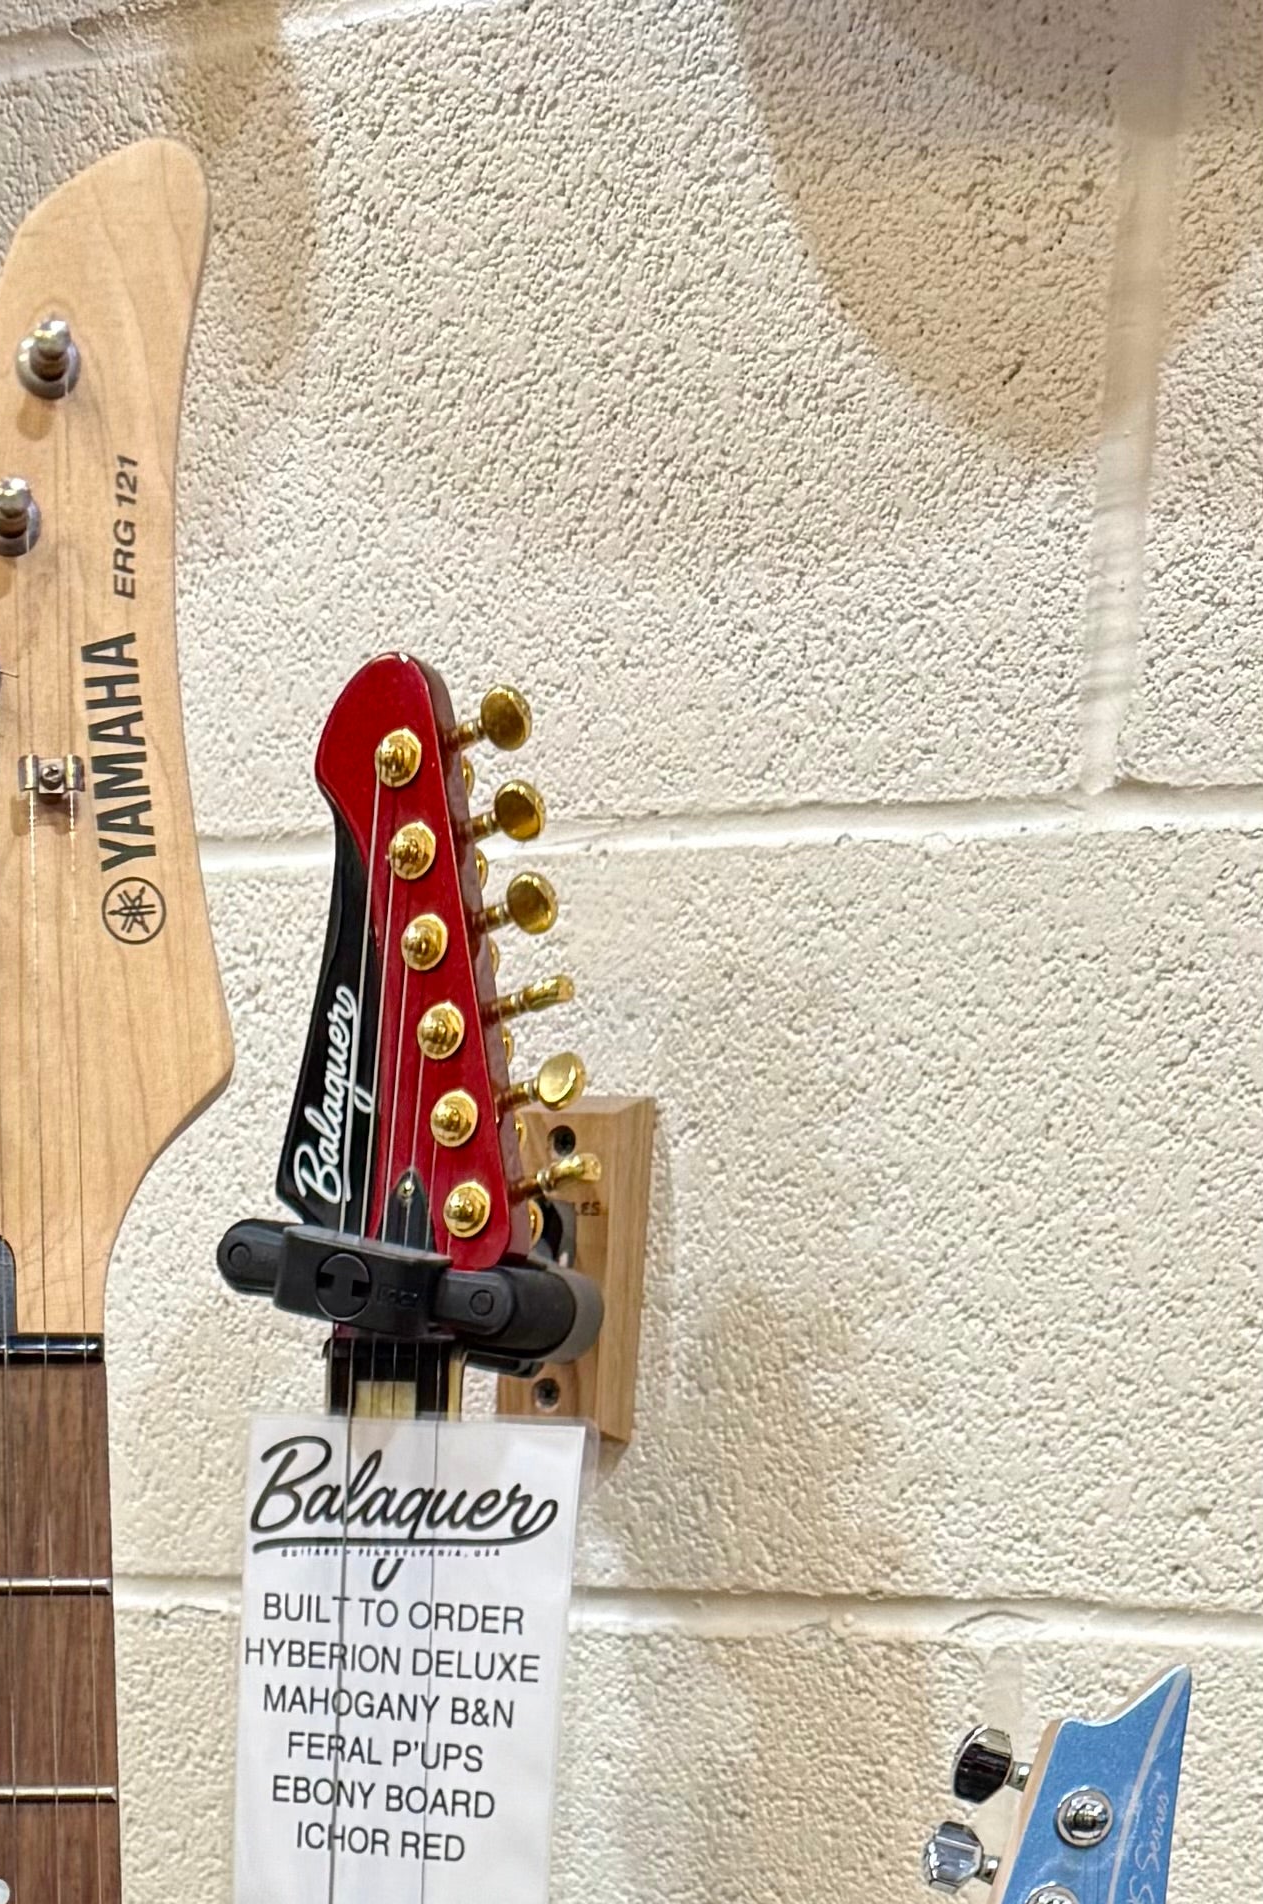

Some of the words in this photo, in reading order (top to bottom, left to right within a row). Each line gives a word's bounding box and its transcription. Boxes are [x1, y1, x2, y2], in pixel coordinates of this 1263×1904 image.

[114, 454, 139, 508] 121
[113, 518, 139, 601] ERG
[81, 631, 157, 872] YAMAHA
[293, 985, 374, 1204] Balaguer
[250, 1435, 559, 1591] Balaguer
[263, 1592, 351, 1623] BUILT
[359, 1597, 398, 1628] TO
[408, 1601, 524, 1636] ORDER
[245, 1637, 401, 1677] HYBERION
[412, 1649, 541, 1684] DELUXE
[263, 1683, 439, 1725] MAHOGANY
[451, 1697, 515, 1730] B&N
[287, 1732, 382, 1767] FERAL
[272, 1775, 376, 1812] EBONY
[385, 1783, 496, 1820] BOARD
[297, 1822, 390, 1859] ICHOR
[401, 1832, 467, 1863] RED
